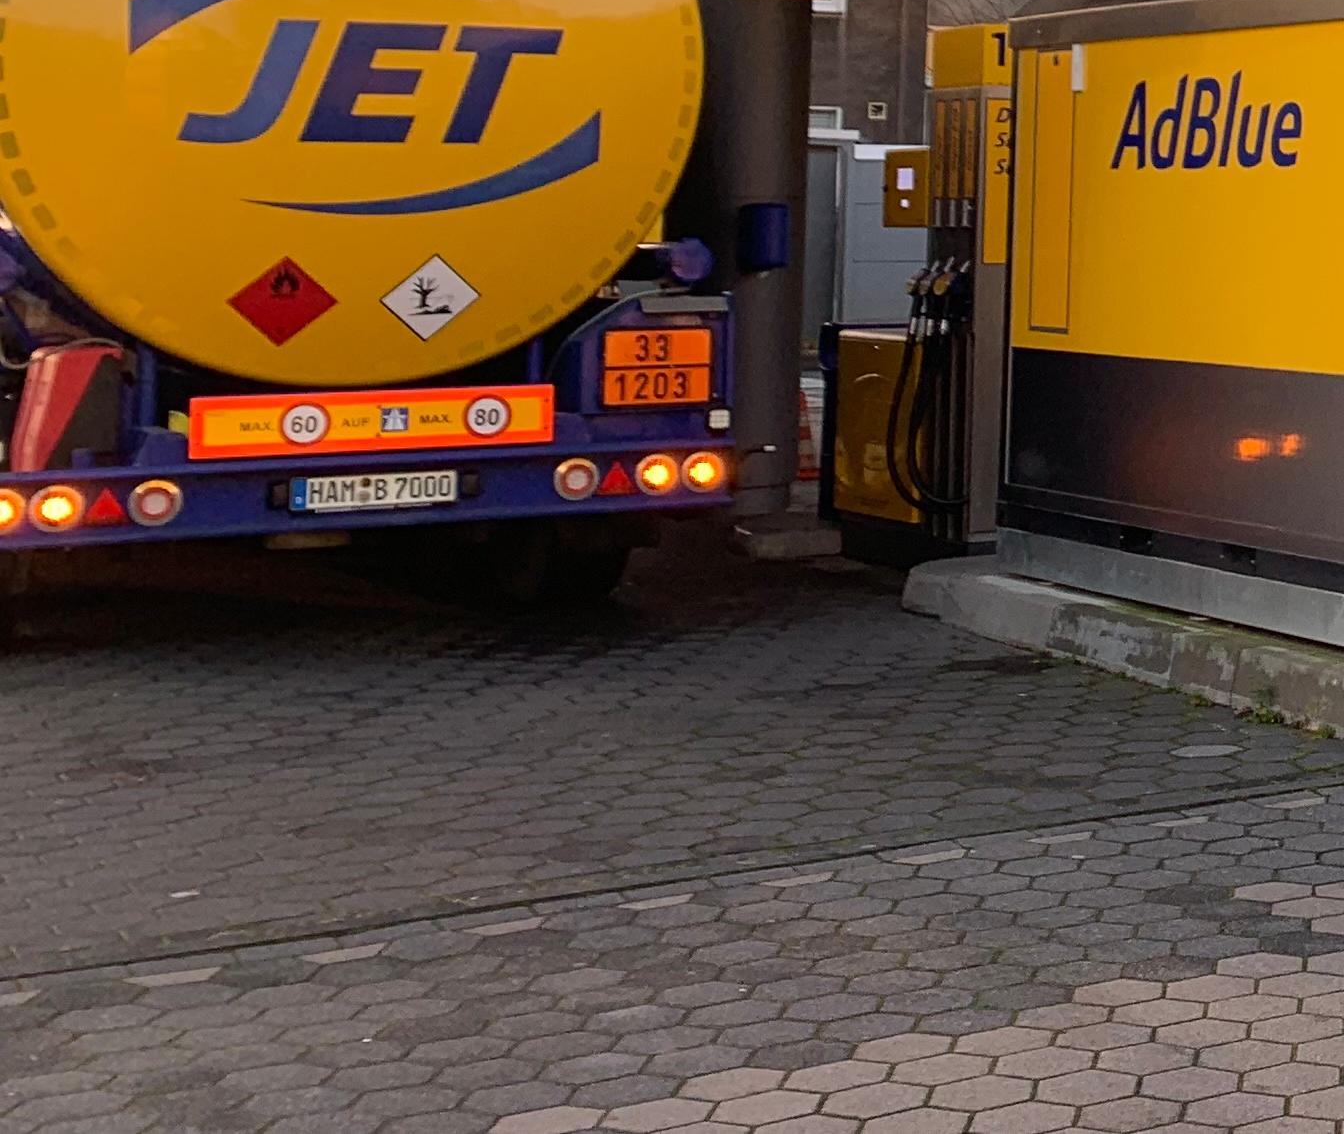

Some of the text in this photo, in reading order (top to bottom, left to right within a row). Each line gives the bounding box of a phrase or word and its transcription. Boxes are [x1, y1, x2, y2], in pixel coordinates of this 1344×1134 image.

[992, 32, 1006, 67] 1
[176, 19, 564, 145] JET
[1110, 70, 1303, 170] AdBlue
[635, 334, 669, 362] 33
[615, 371, 688, 401] 1203
[291, 415, 318, 434] 60
[342, 417, 370, 427] AUF
[474, 408, 500, 426] 80
[309, 479, 355, 504] HAM
[374, 478, 387, 501] B
[395, 474, 450, 500] 7000
